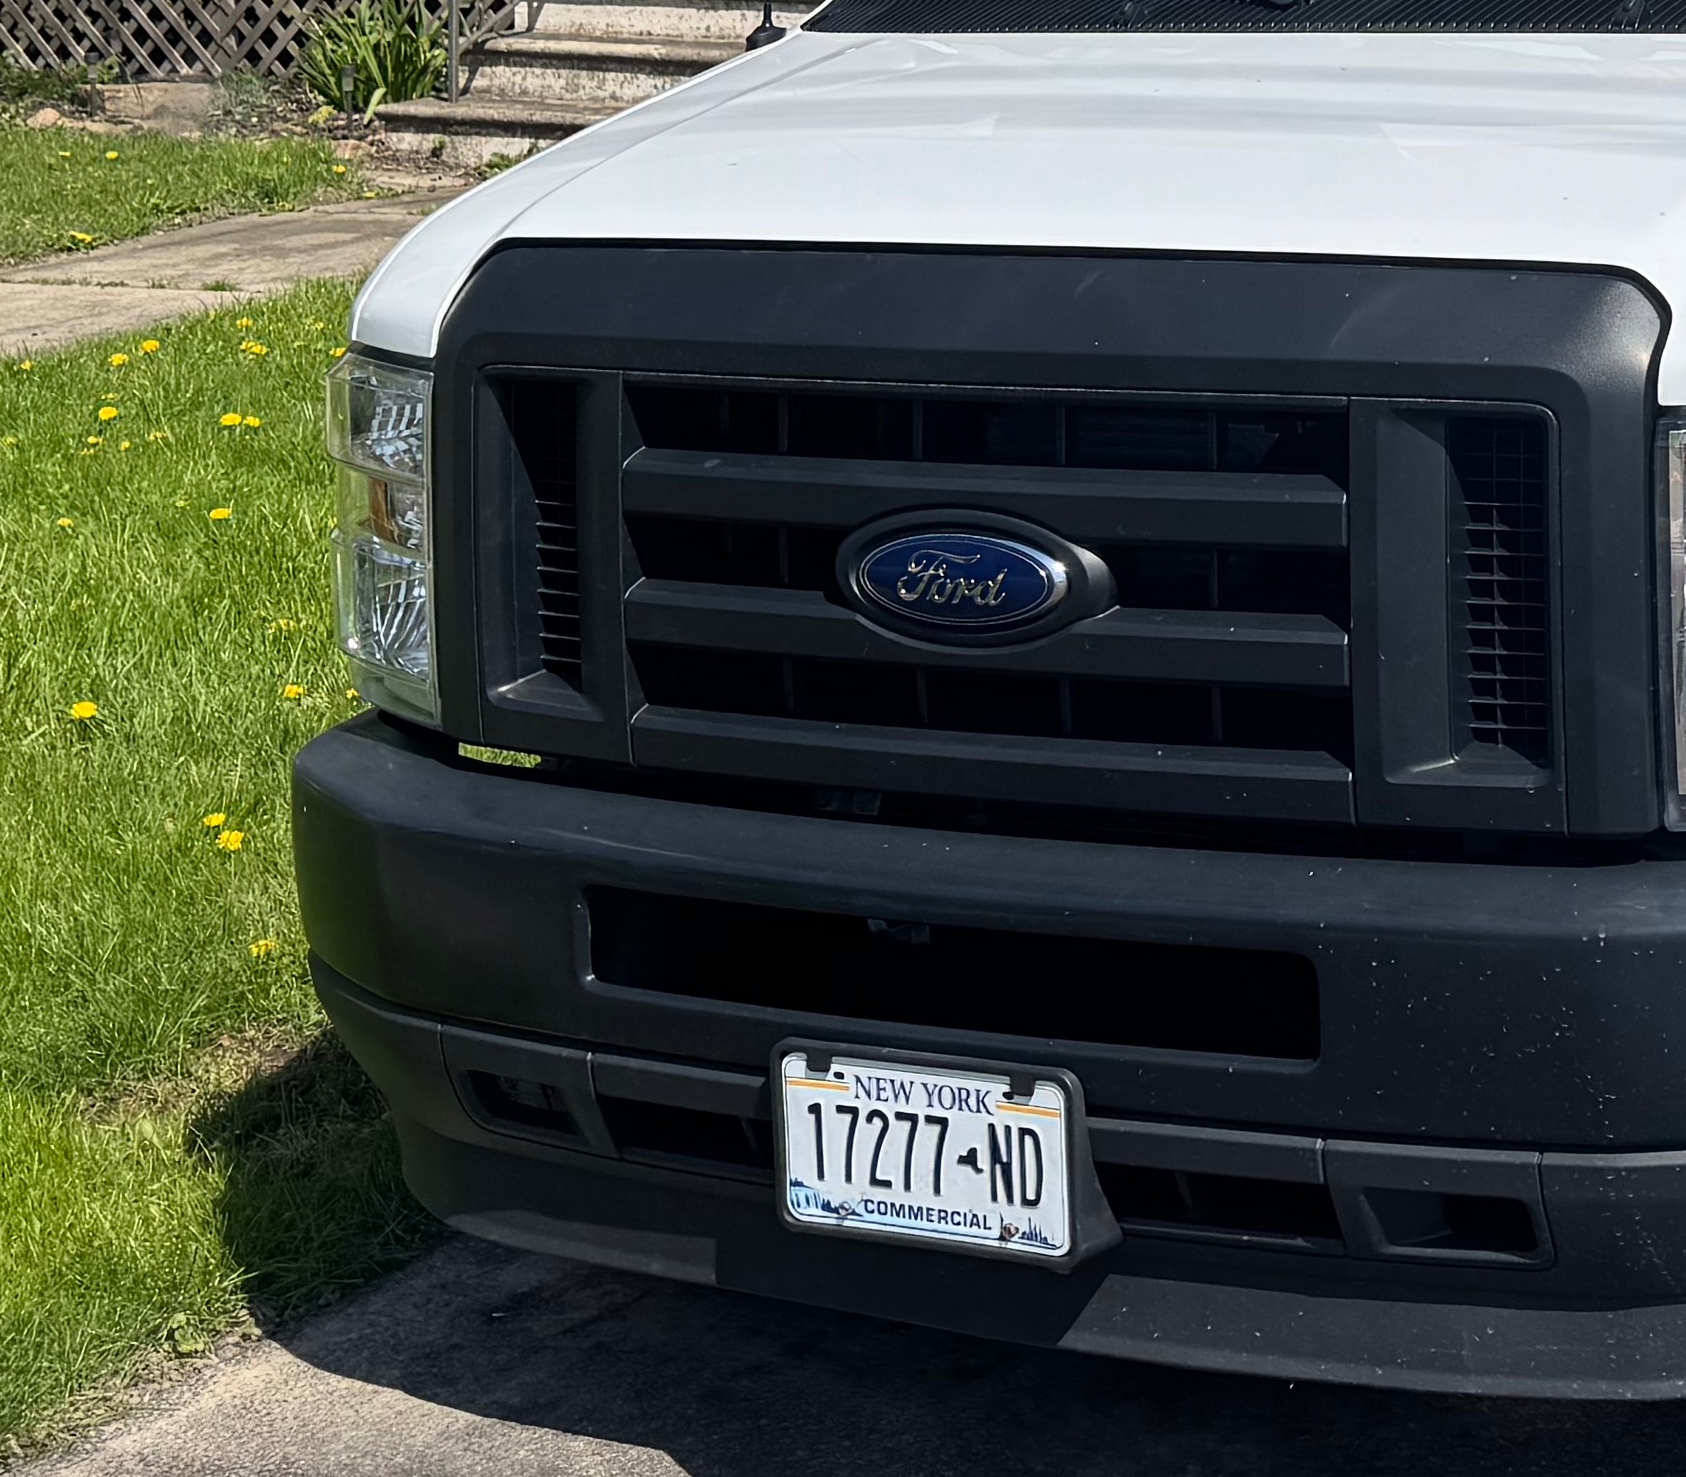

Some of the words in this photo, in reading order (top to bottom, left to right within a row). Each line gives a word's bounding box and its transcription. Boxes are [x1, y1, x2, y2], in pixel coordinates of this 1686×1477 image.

[896, 548, 1008, 608] Ford
[853, 1075, 915, 1105] NEW
[920, 1081, 994, 1116] YORK
[807, 1101, 949, 1198] 17277
[987, 1122, 1044, 1209] ND
[863, 1197, 993, 1232] COMMERCIAL
